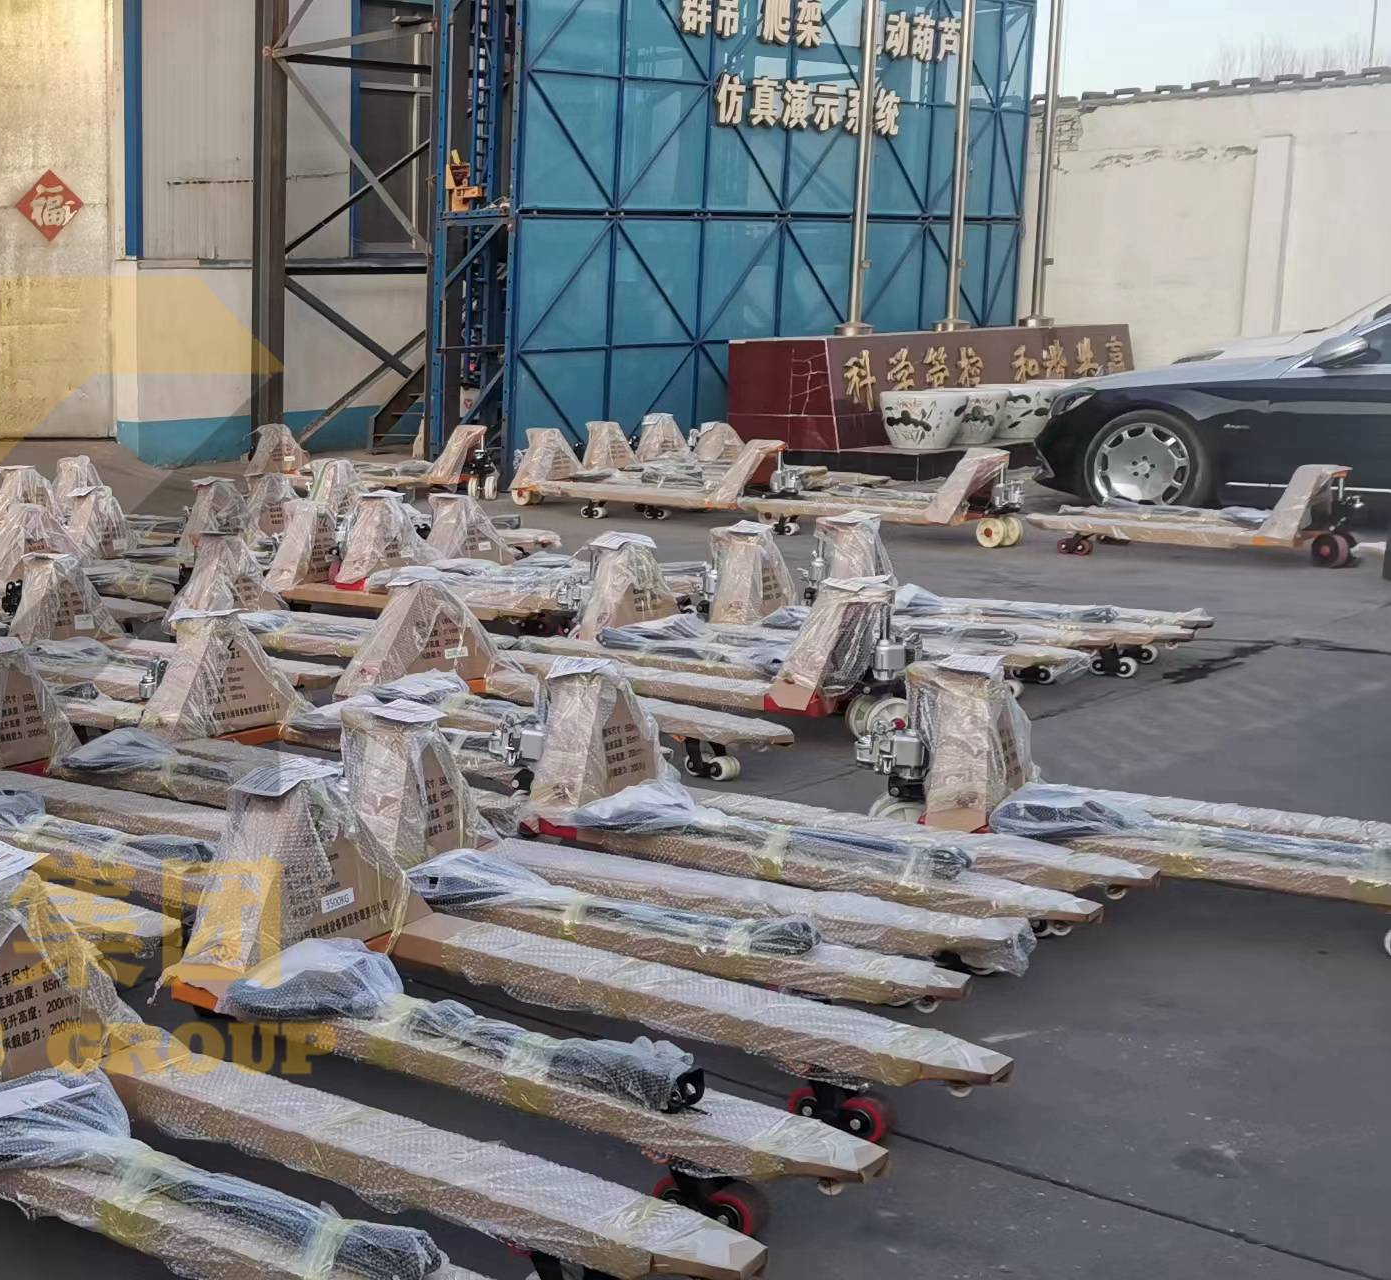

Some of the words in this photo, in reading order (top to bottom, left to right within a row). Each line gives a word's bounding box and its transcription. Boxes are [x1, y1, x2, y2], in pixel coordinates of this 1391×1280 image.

[715, 73, 901, 136] 仿真演示系统
